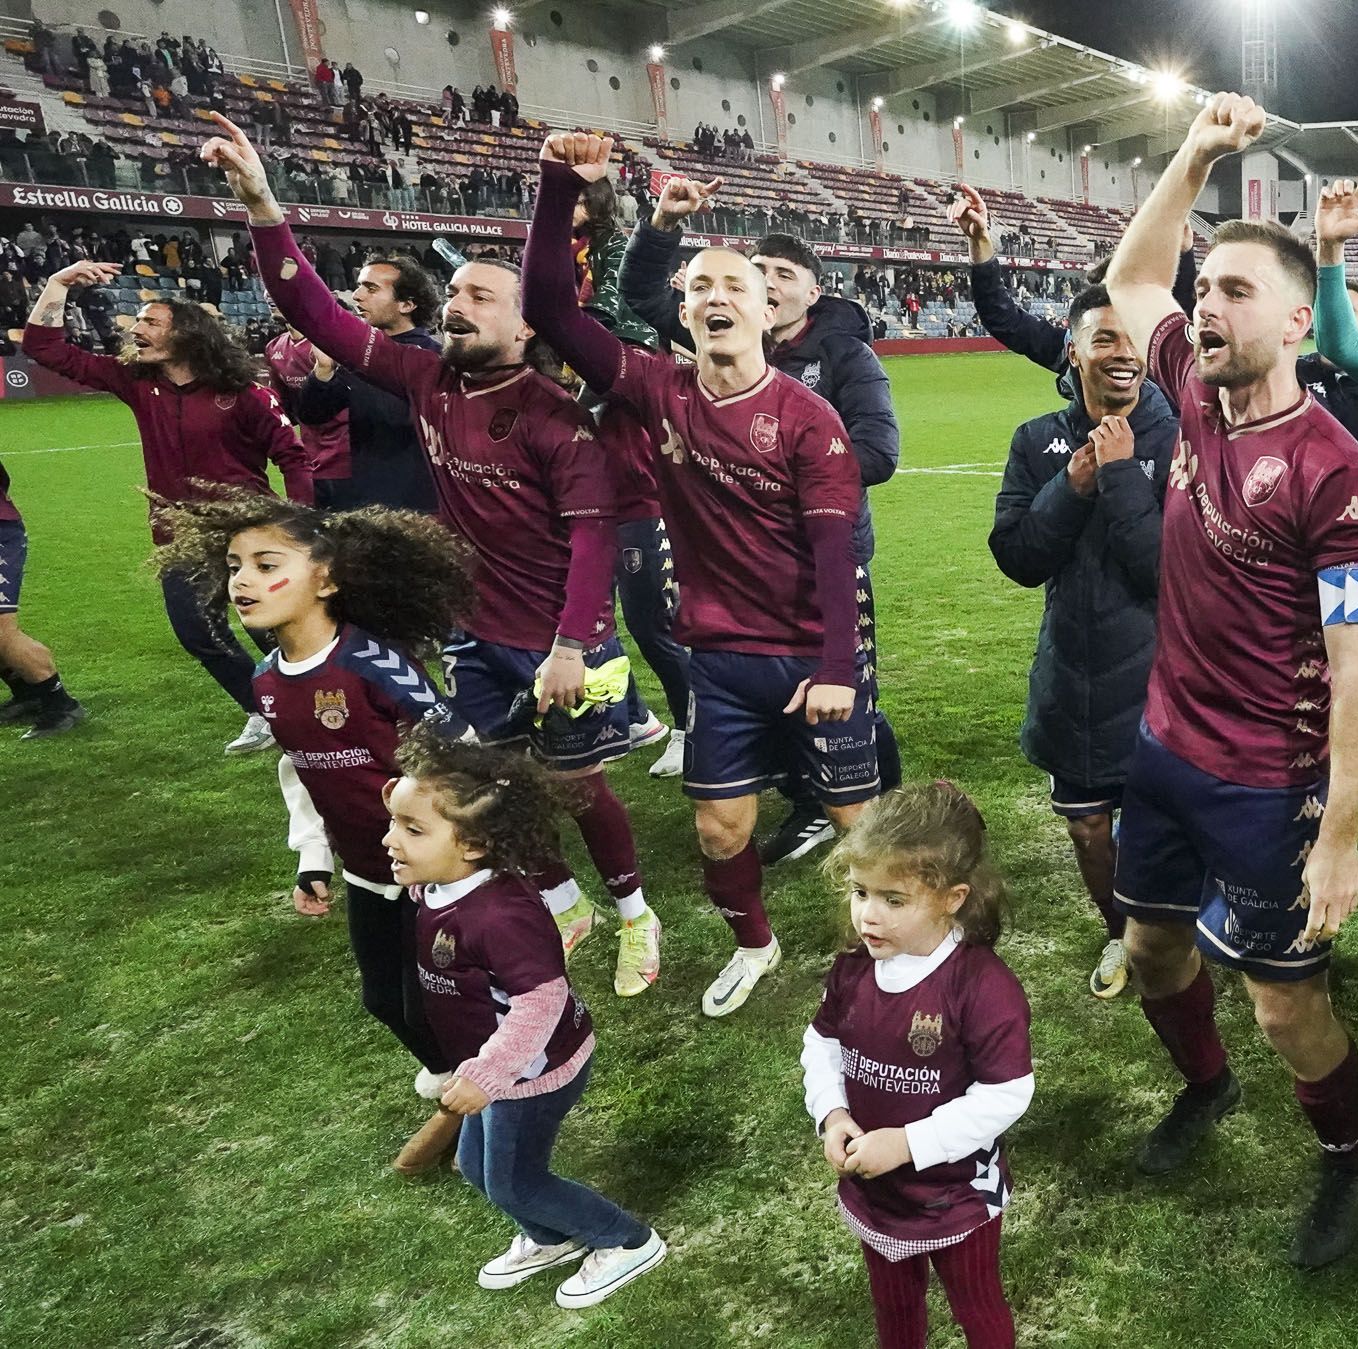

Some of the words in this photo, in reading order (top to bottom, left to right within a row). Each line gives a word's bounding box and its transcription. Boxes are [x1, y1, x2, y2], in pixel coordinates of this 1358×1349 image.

[12, 187, 91, 210] Estrella
[92, 192, 160, 213] Galicia
[401, 219, 432, 231] HOTEL
[434, 222, 470, 233] GALICIA
[470, 225, 503, 236] PALACE
[1195, 482, 1274, 552] Deputación
[306, 746, 370, 762] DEPUTACIÓN
[308, 755, 375, 770] PONTEVEDRA
[1227, 884, 1259, 898] XUNTA
[1227, 893, 1237, 904] DE
[1240, 896, 1279, 909] GALICIA
[860, 1055, 941, 1081] DEPUTACIÓN
[857, 1069, 941, 1095] PONTEVEDRA
